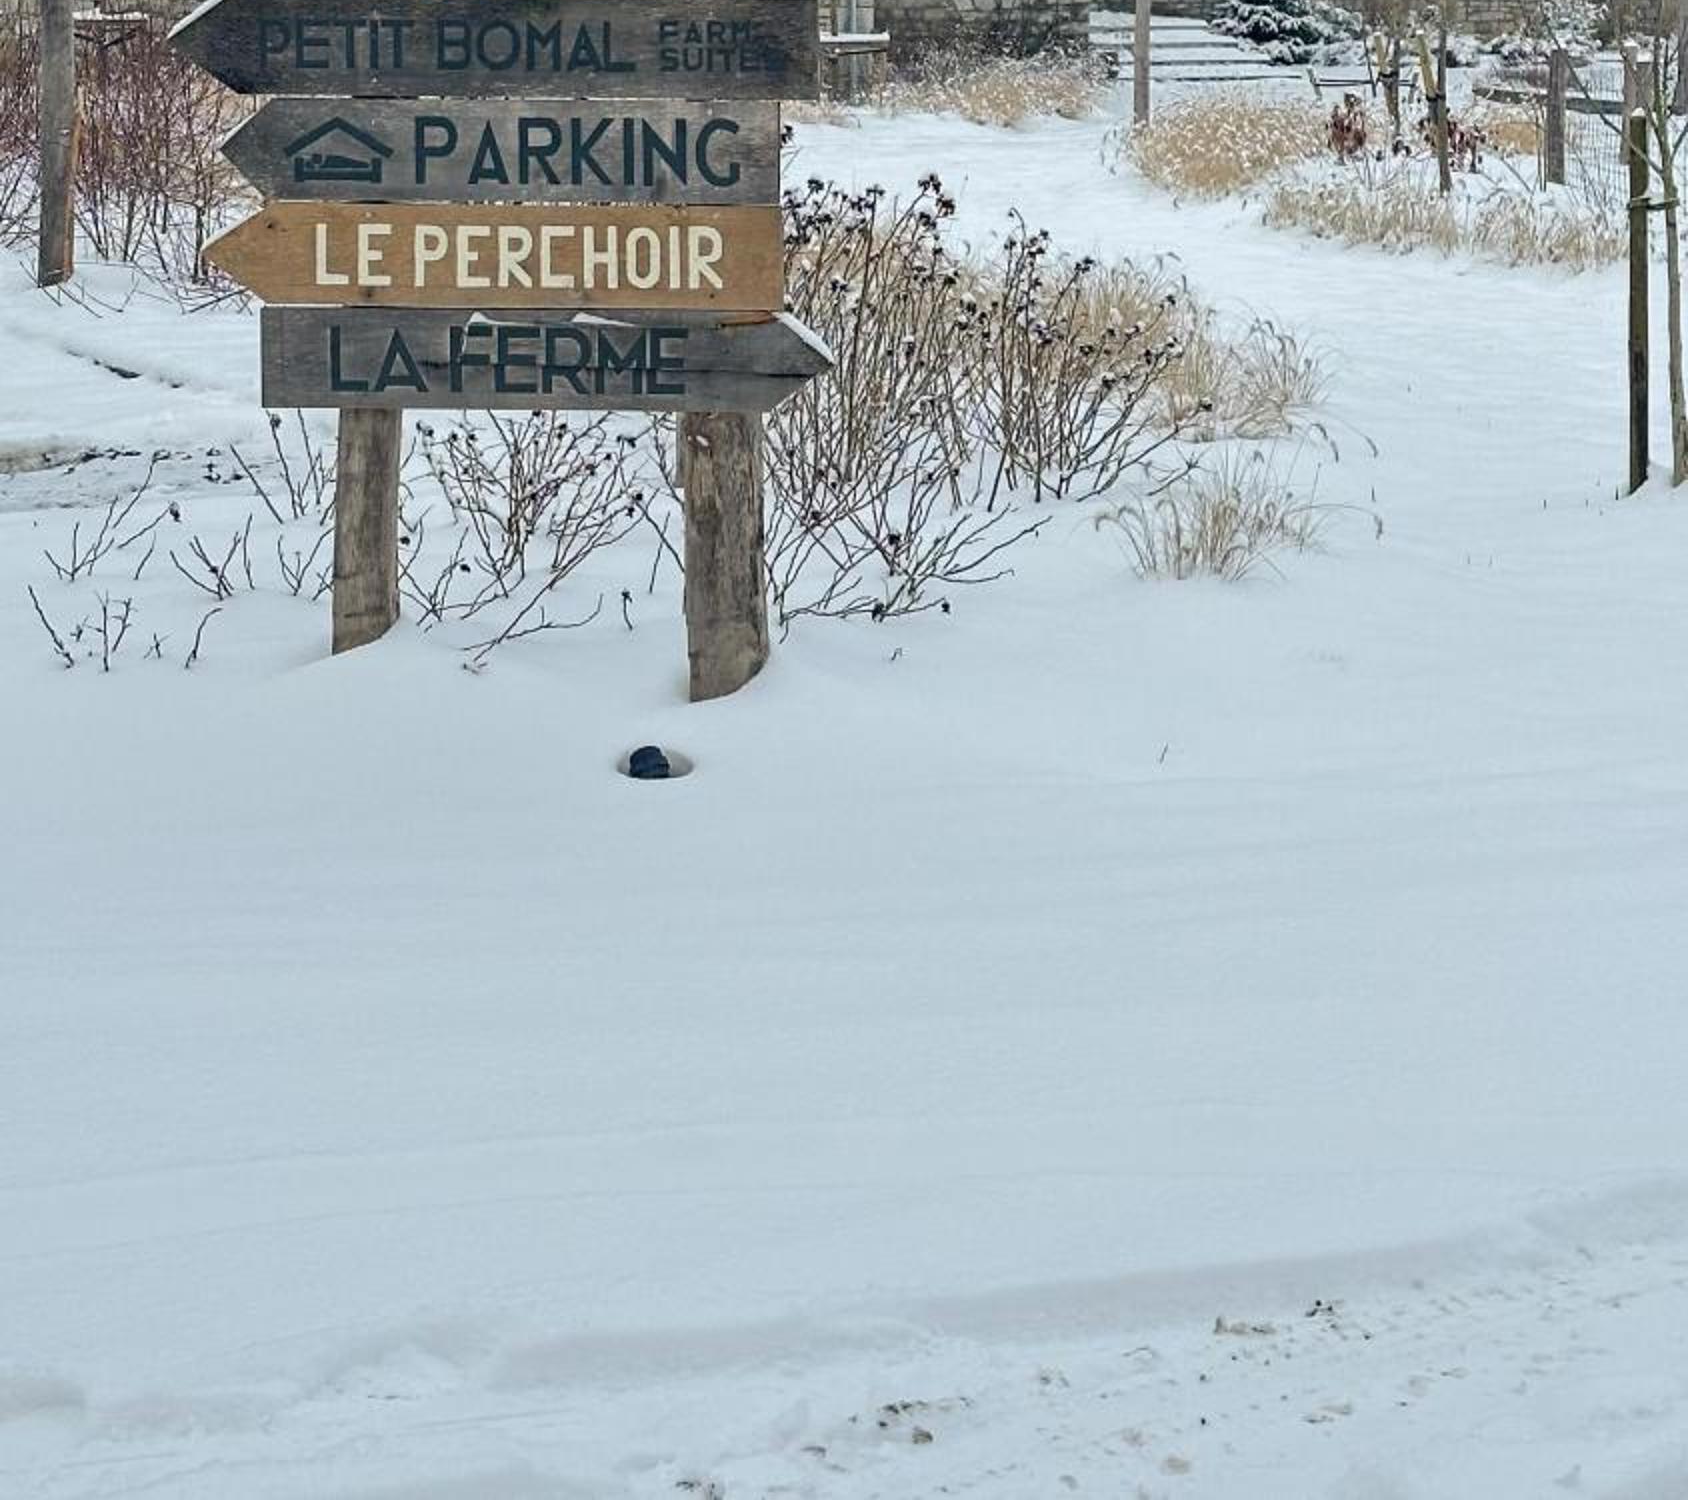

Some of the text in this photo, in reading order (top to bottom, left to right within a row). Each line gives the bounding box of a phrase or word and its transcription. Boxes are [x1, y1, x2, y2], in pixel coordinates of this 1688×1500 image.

[258, 19, 637, 73] PETIT BOMAL
[659, 20, 751, 44] FARM
[415, 117, 741, 187] PARKING
[315, 223, 724, 291] LE PERCHOIR
[330, 325, 689, 396] LA FERME
